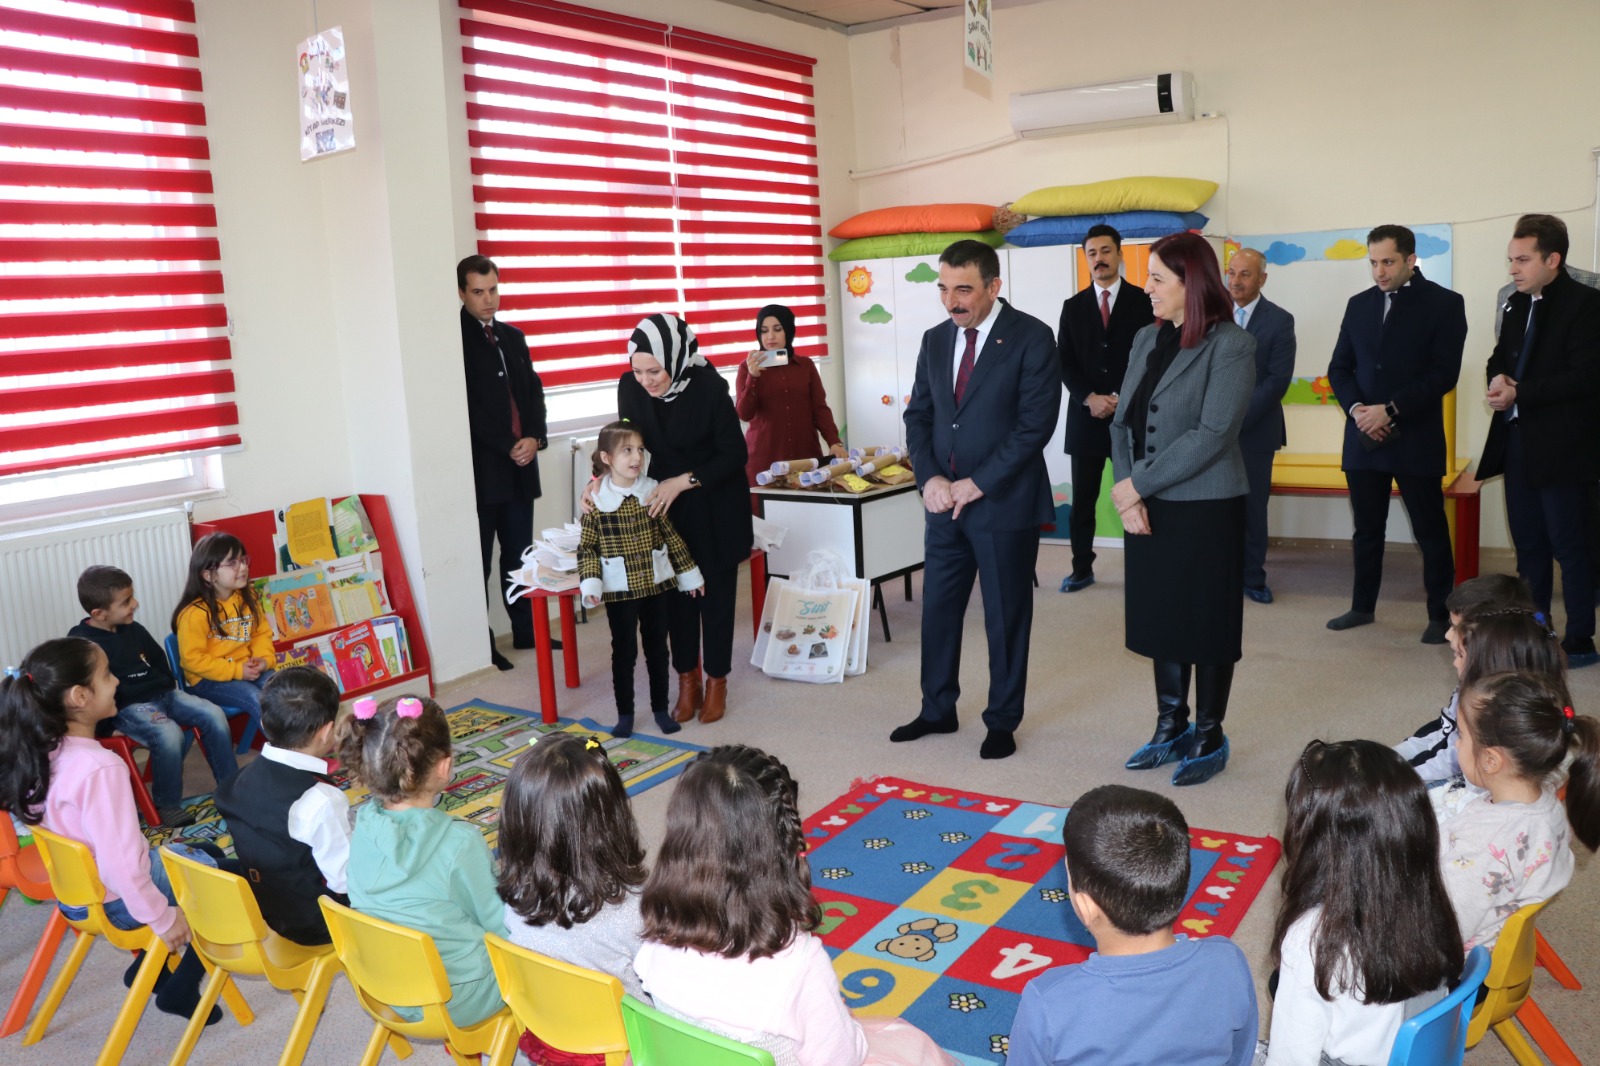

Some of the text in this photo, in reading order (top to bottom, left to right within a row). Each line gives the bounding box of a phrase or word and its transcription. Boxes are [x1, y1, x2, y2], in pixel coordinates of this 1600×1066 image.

[1023, 812, 1056, 834] 1
[985, 842, 1041, 871] 2
[940, 879, 1000, 911] 3
[990, 943, 1053, 979] 4
[839, 968, 896, 1009] 6
